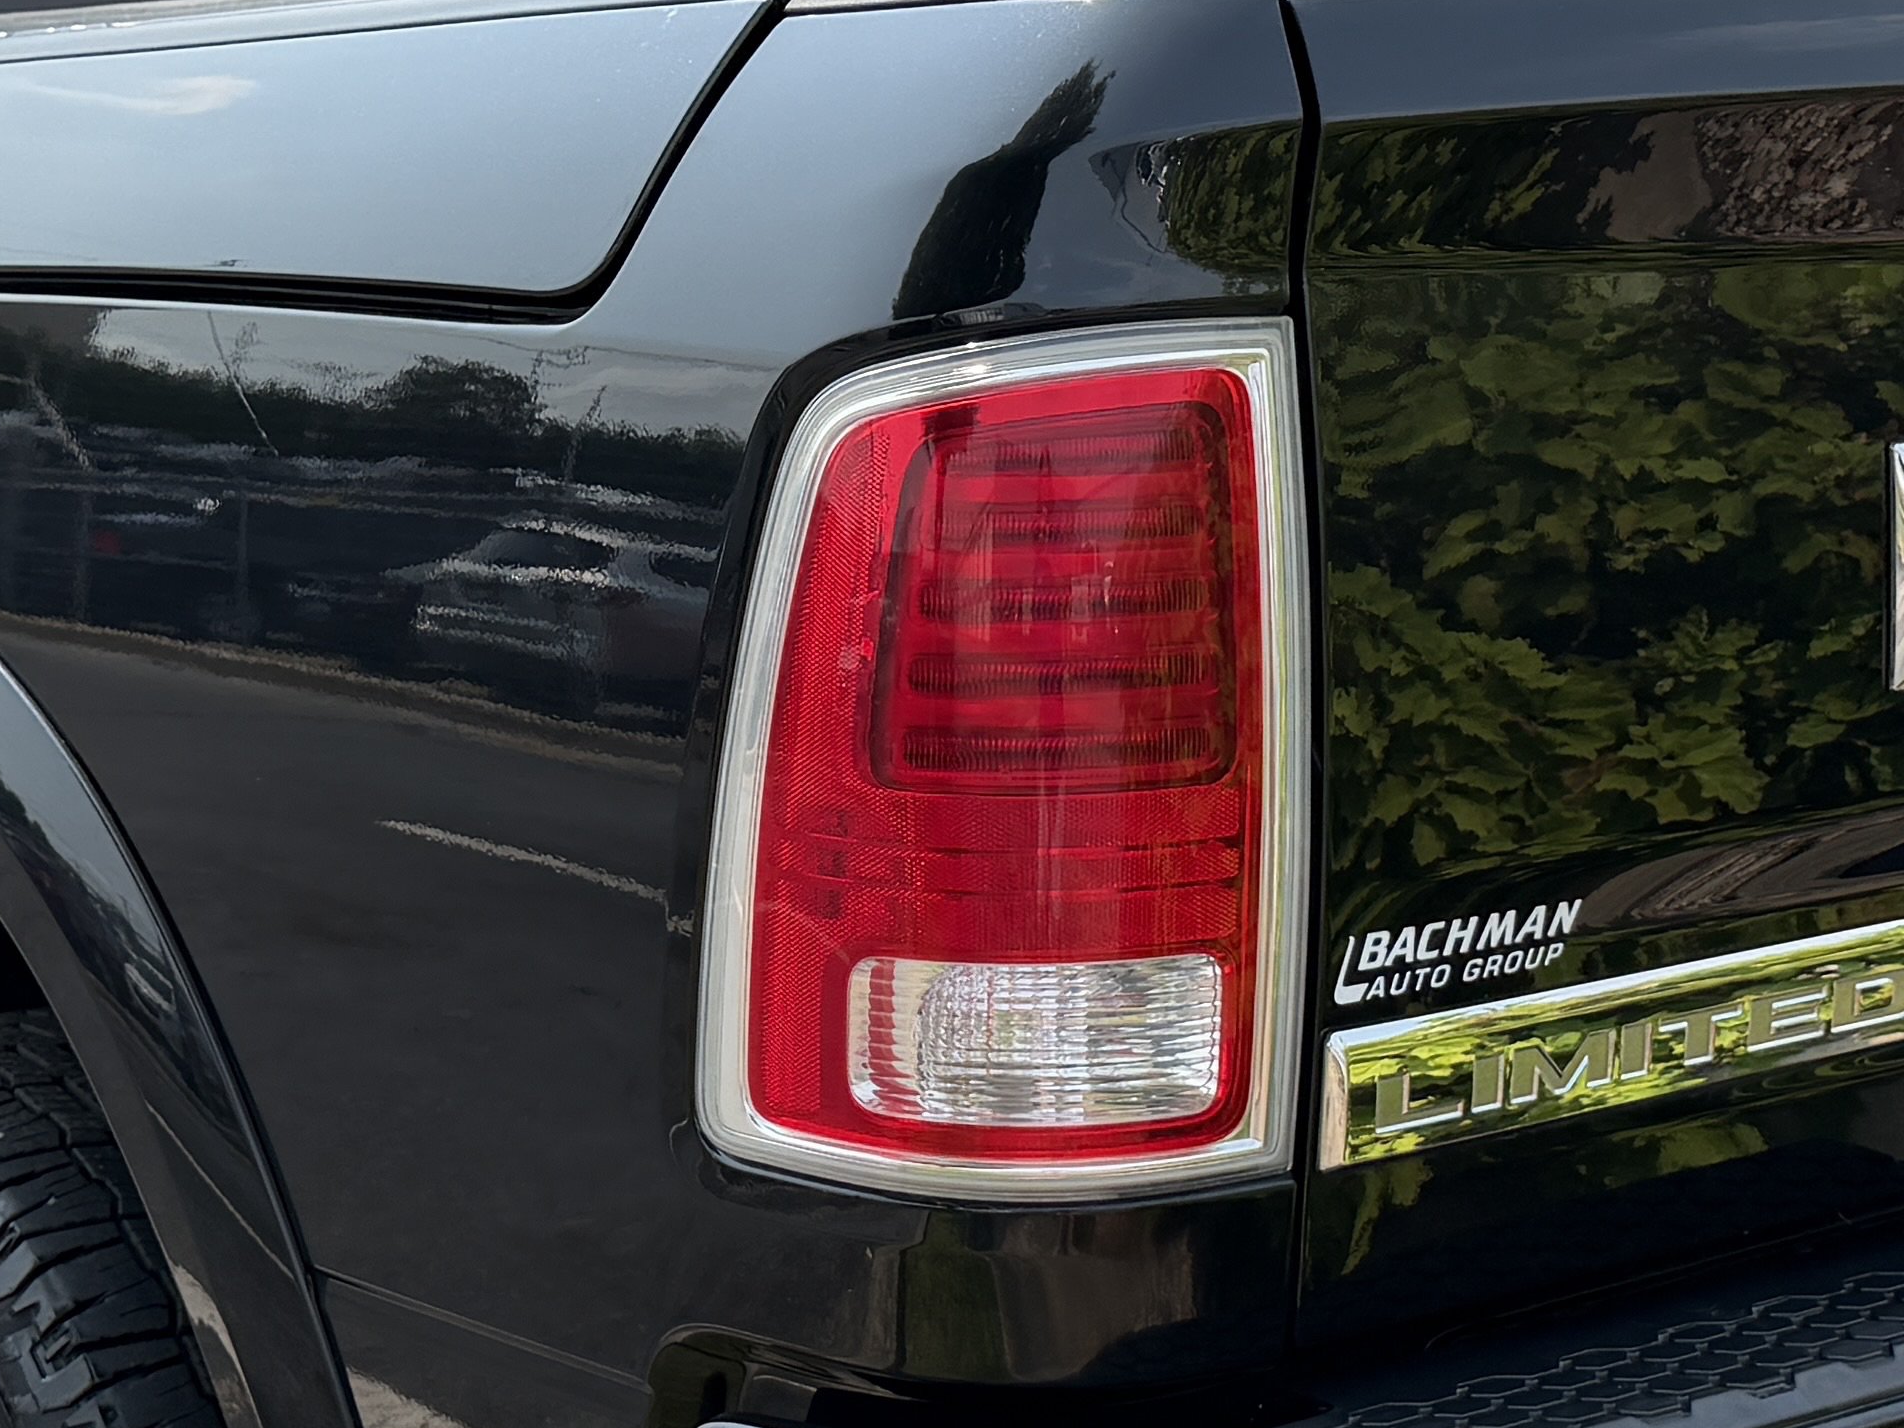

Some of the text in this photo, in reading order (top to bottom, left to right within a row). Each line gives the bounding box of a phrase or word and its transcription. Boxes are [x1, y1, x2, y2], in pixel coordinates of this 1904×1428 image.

[1358, 898, 1583, 970] BACHMAN
[1365, 942, 1565, 1001] AUTO GROUP
